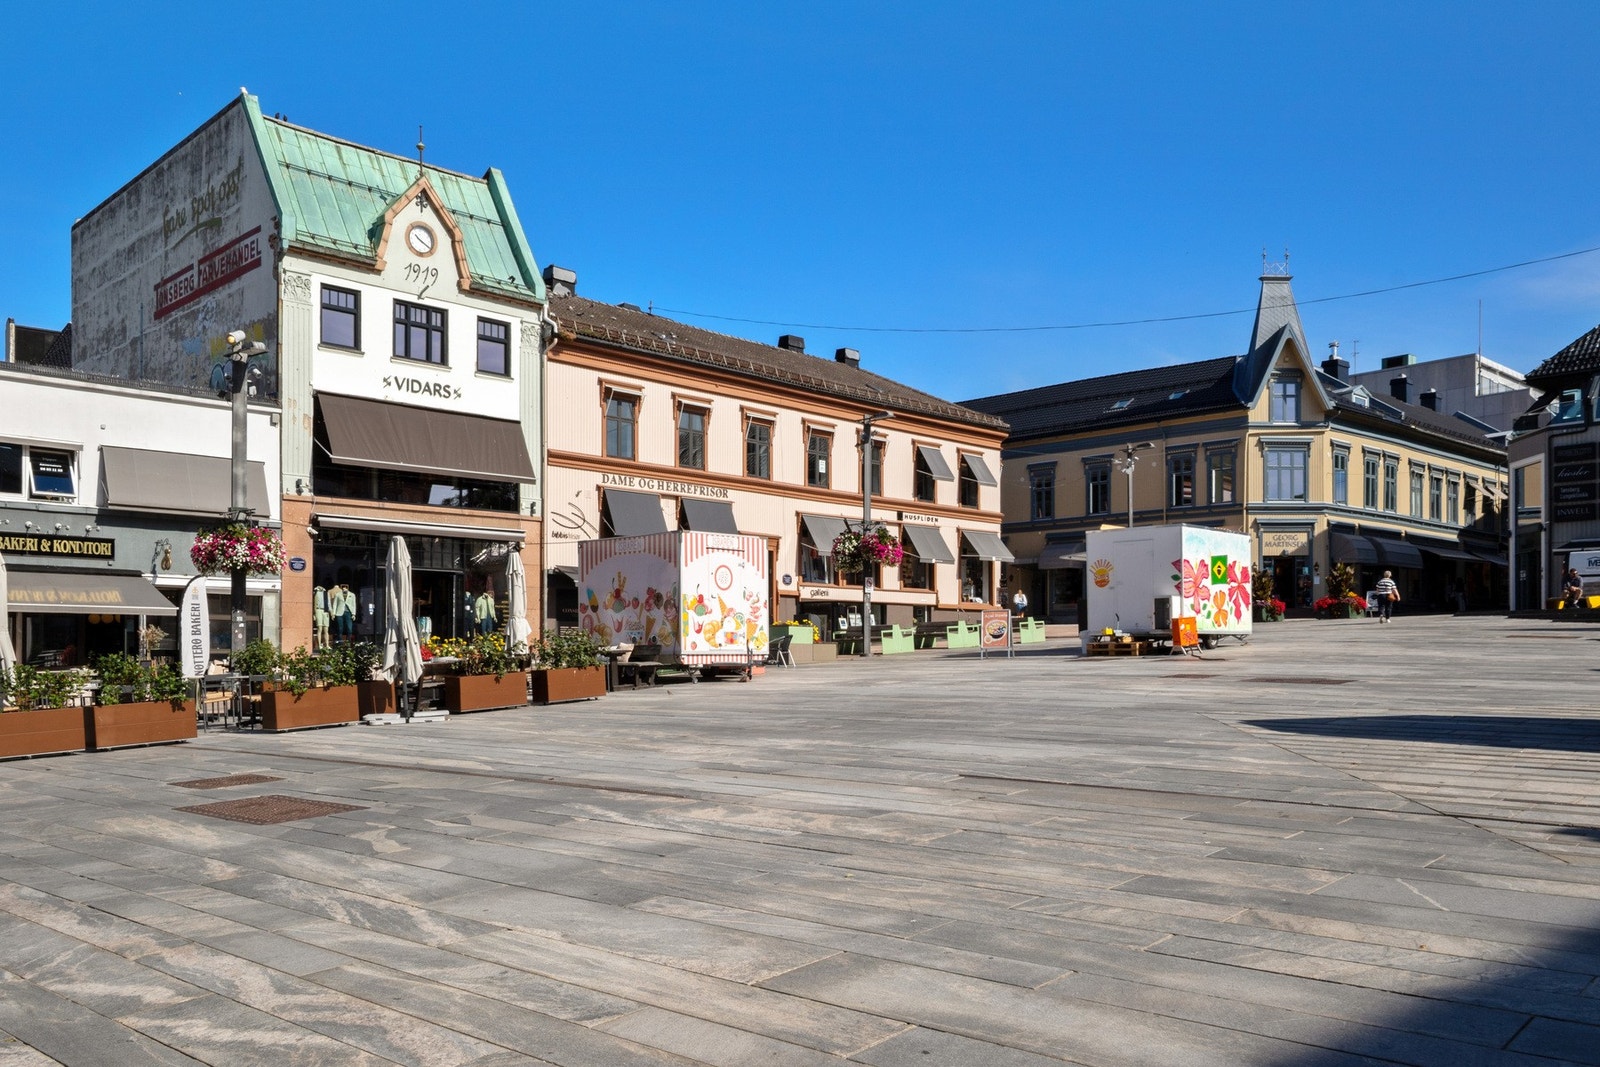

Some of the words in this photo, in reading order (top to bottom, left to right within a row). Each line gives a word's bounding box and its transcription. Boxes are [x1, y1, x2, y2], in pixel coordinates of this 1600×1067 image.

[198, 238, 262, 288] FARVEHANDEL
[404, 262, 439, 287] 1919
[394, 376, 452, 399] VIDARS
[601, 473, 635, 487] DAME
[638, 478, 655, 490] OG
[657, 480, 729, 499] HERREFRISØR
[904, 514, 939, 523] HUSFLIDEN
[1557, 507, 1591, 517] INWELL
[40, 538, 51, 552] &
[53, 539, 112, 556] KONDITORI
[1272, 534, 1299, 542] GEORG
[191, 603, 202, 636] BAKERI
